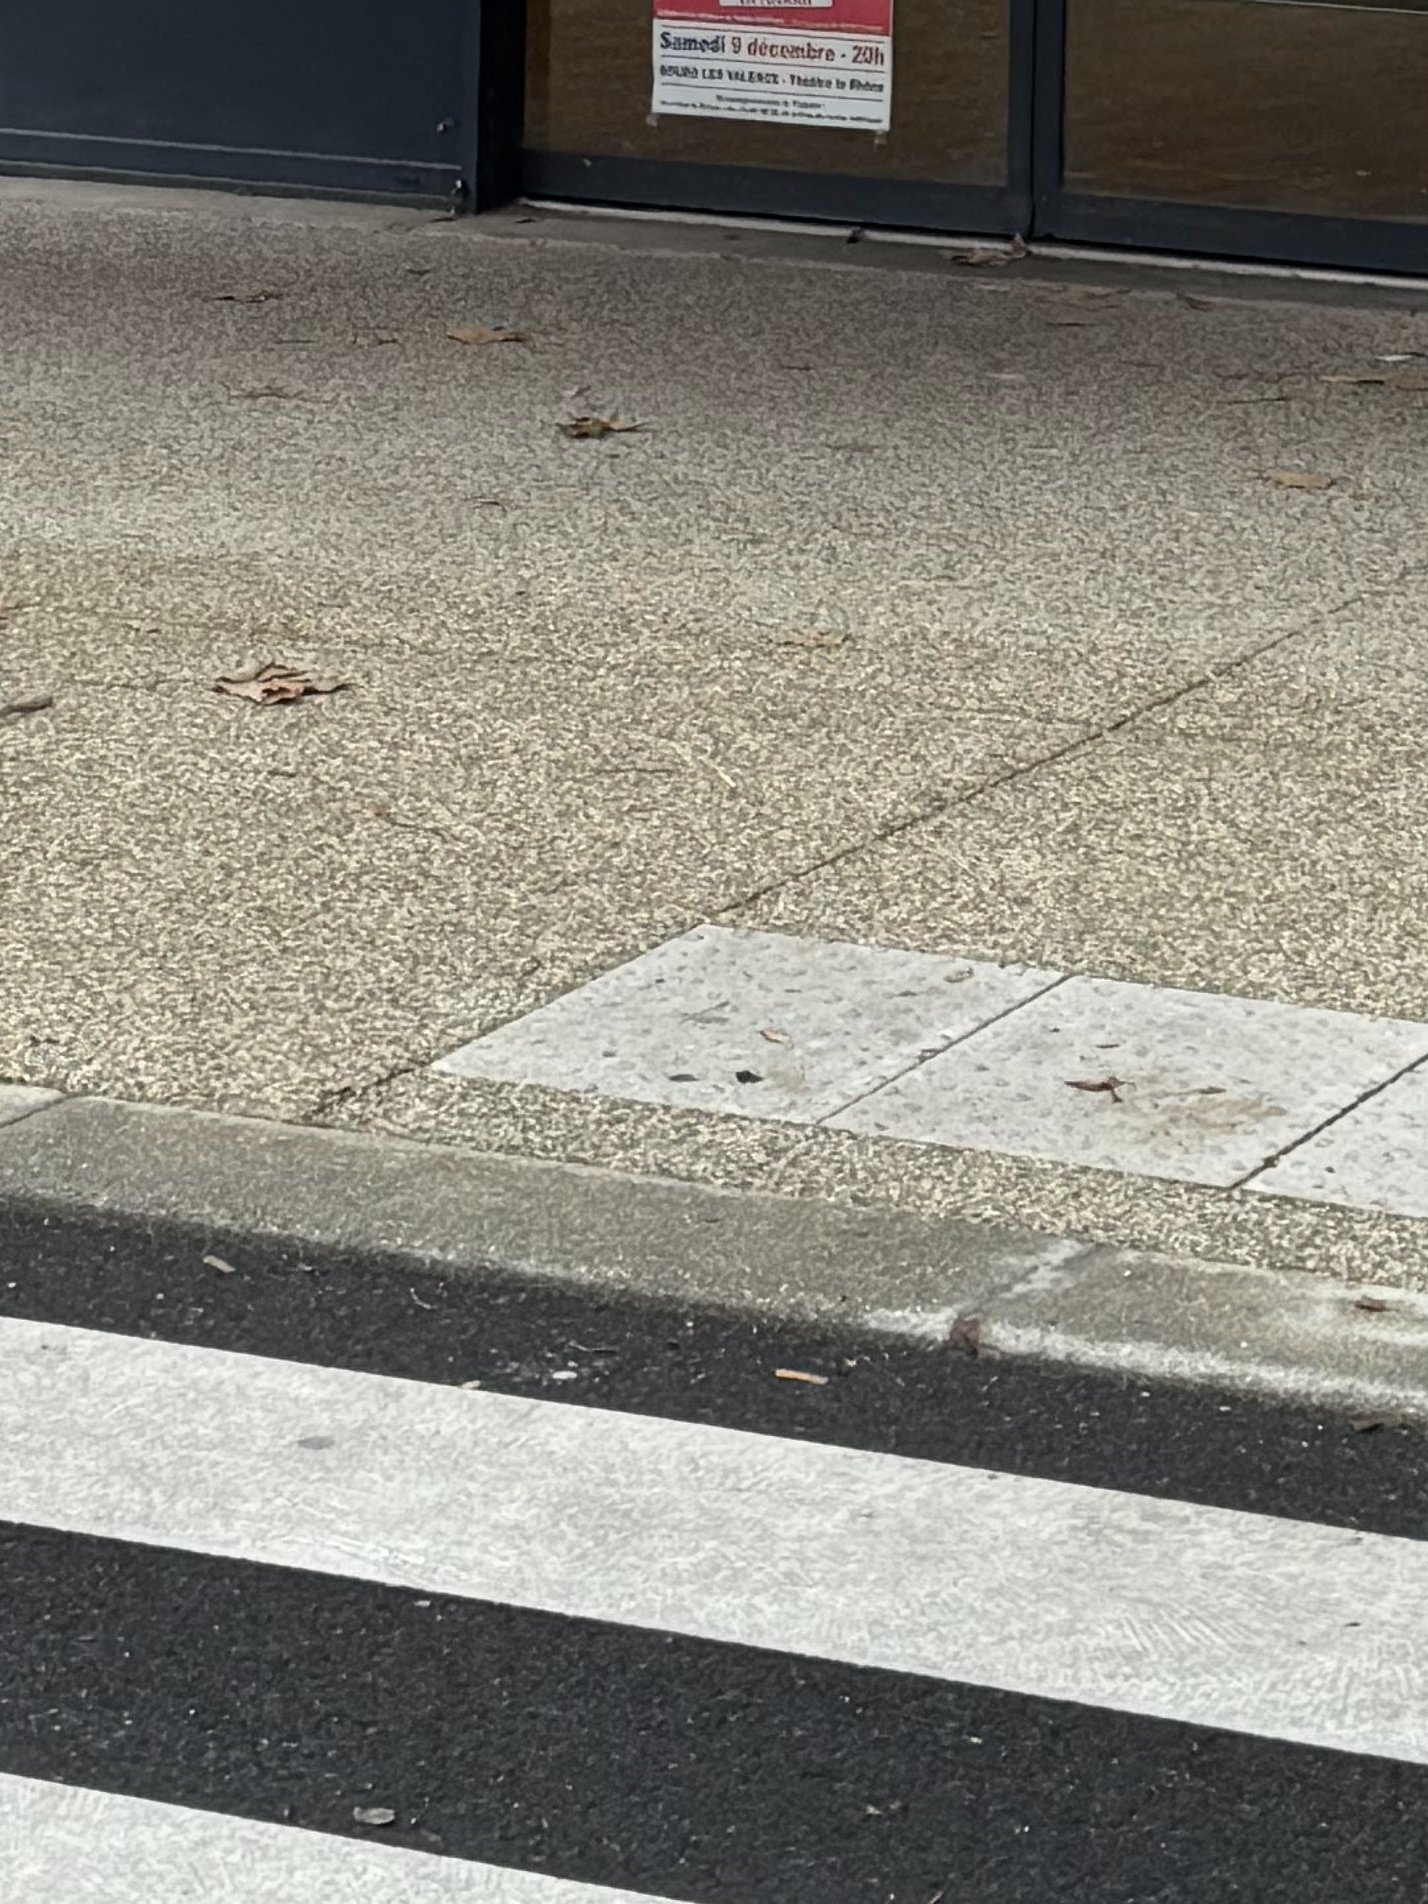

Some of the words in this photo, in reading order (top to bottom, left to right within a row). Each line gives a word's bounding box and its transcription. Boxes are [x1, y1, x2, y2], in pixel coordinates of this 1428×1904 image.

[659, 32, 726, 53] Samedi
[731, 36, 742, 55] 9
[747, 38, 835, 62] décembre
